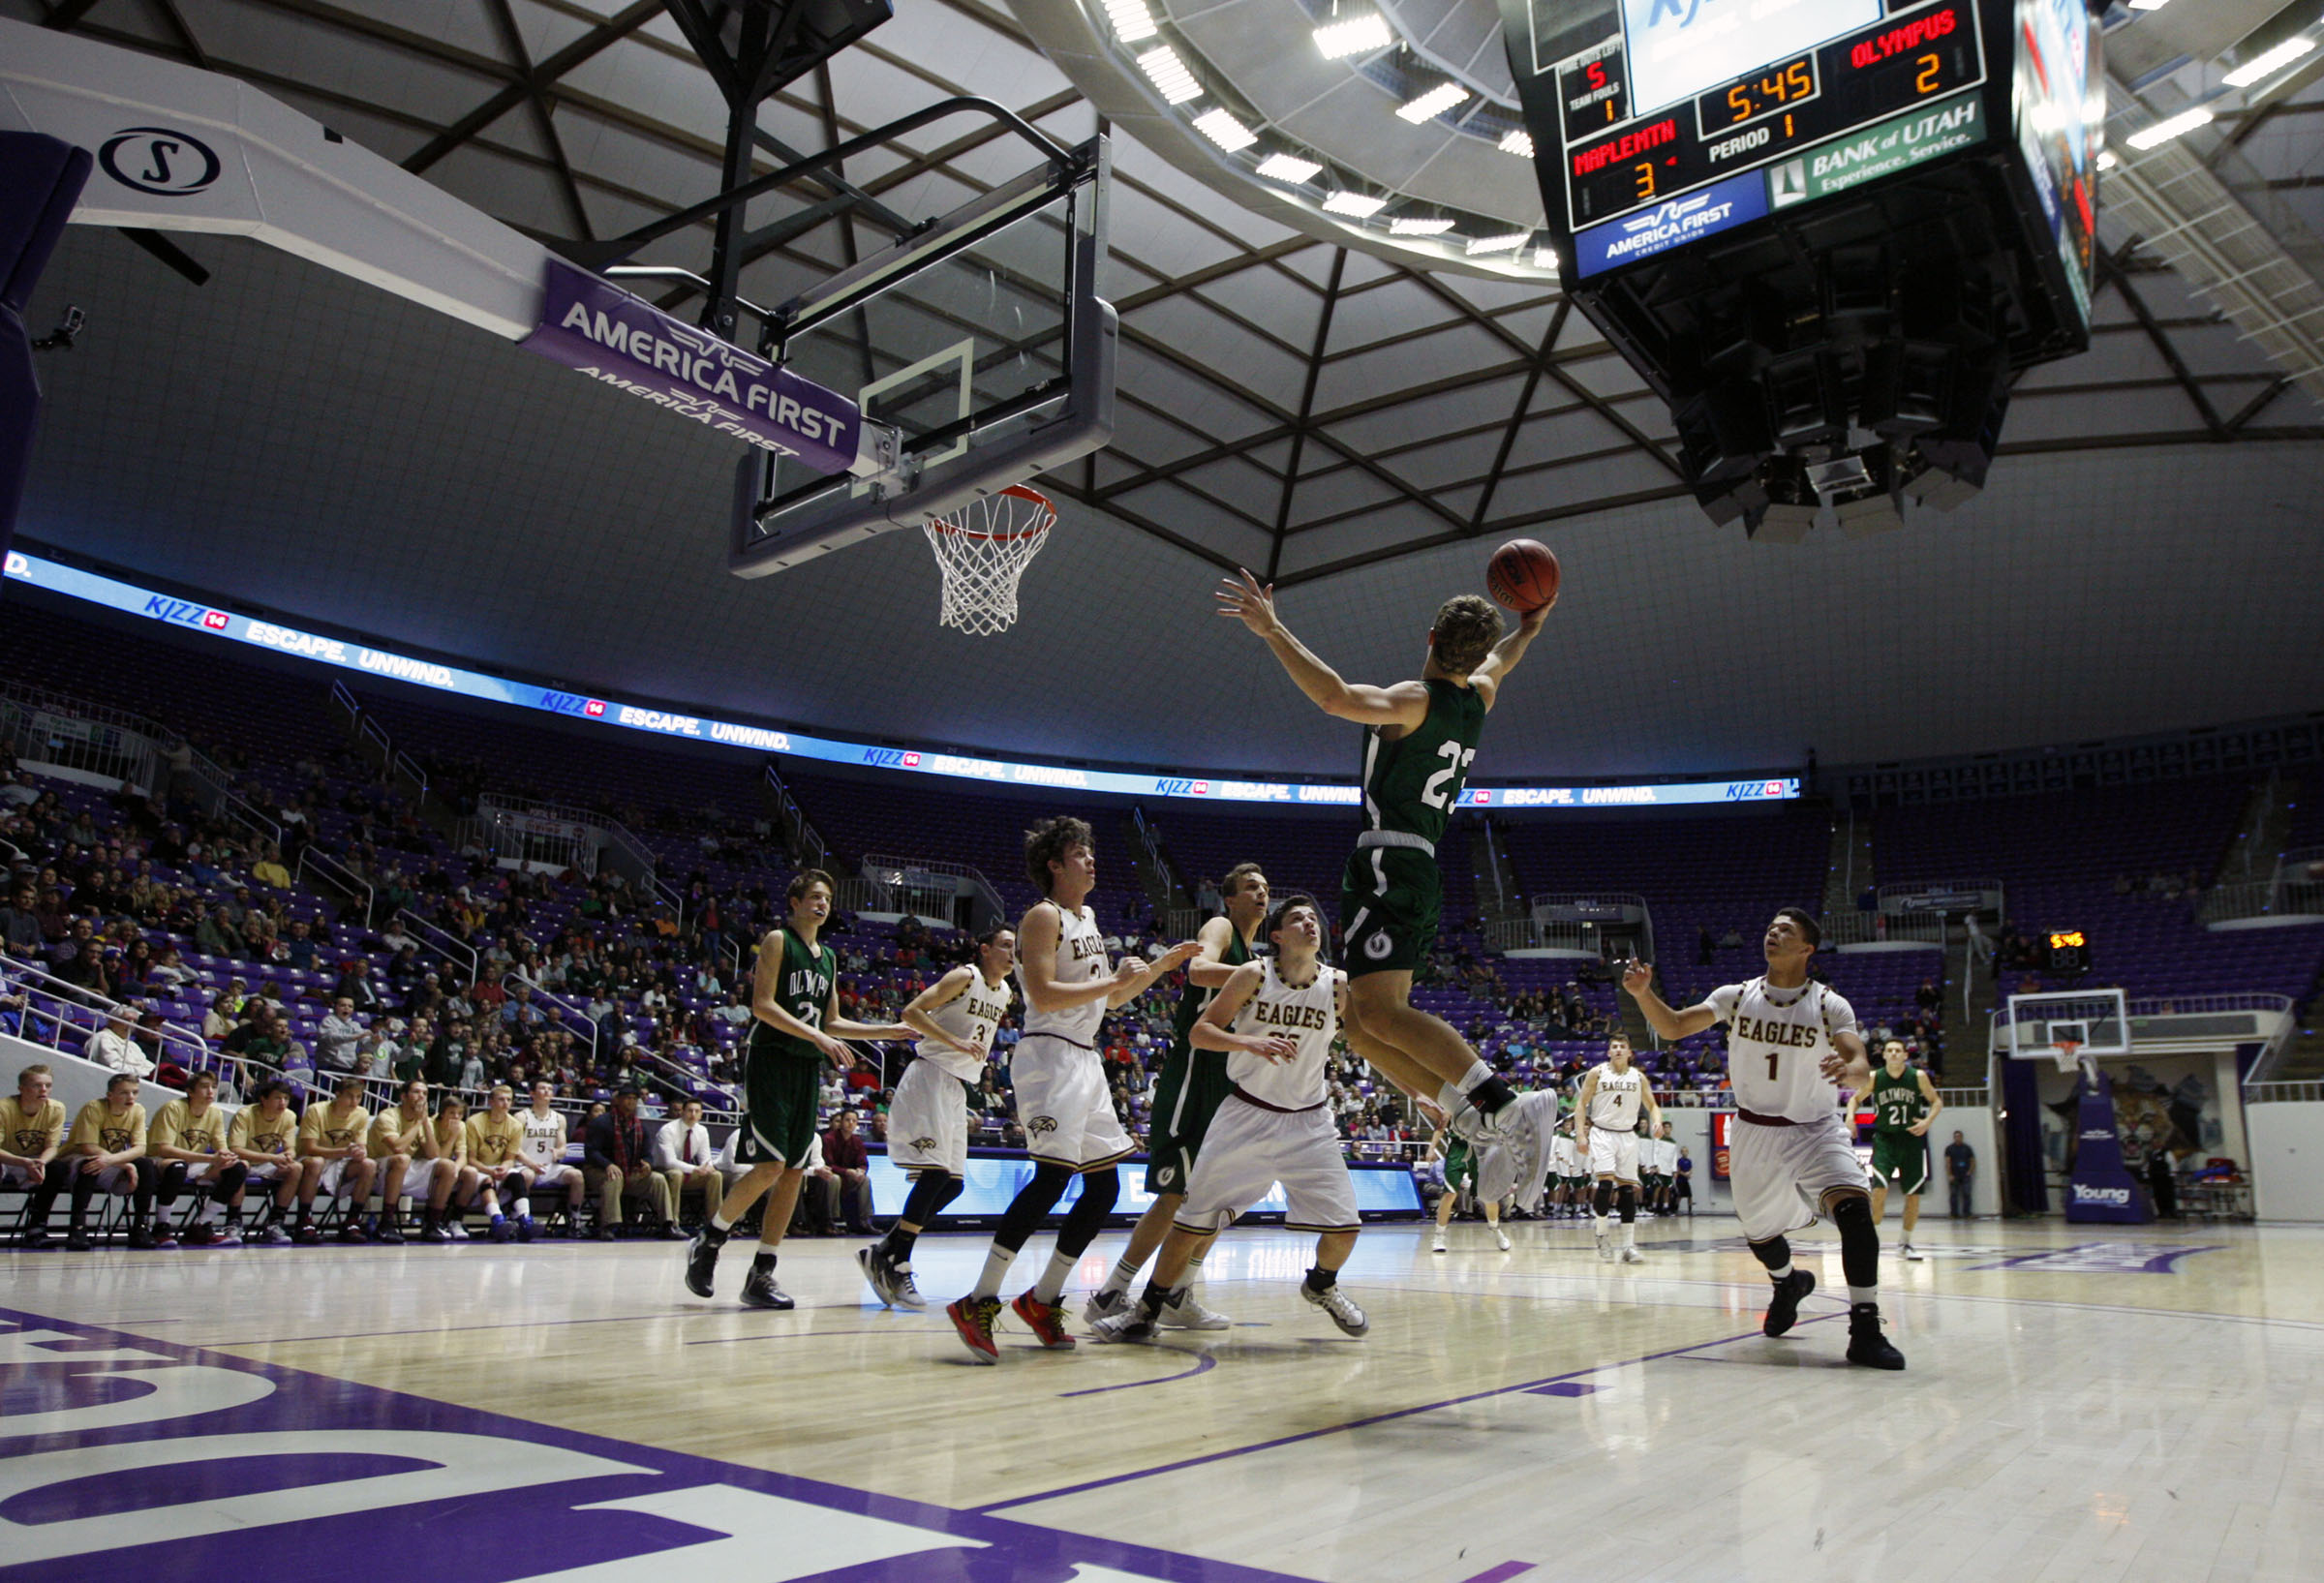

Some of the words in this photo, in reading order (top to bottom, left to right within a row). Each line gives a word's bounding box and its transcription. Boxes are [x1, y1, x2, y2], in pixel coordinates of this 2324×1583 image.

[1850, 9, 1956, 69] OLYMPUS
[1915, 53, 1940, 93] 2
[1569, 91, 1593, 111] TEAM
[1593, 81, 1620, 102] FOULS
[1728, 61, 1812, 122] 5:45
[1605, 100, 1614, 122] 1
[1785, 114, 1793, 137] 1
[1709, 127, 1770, 163] PERIOD
[1812, 136, 1880, 178] BANK
[1881, 131, 1900, 150] of
[1903, 101, 1976, 143] UTAH
[1820, 155, 1908, 194] Experience.
[1909, 132, 1972, 163] Service.
[1635, 162, 1655, 198] 3
[1606, 222, 1682, 259] AMERICA
[1682, 201, 1733, 232] FIRST
[1635, 240, 1669, 257] CREDIT
[1674, 228, 1705, 243] UNION
[561, 301, 741, 404] AMERICA
[747, 382, 847, 447] FIRST
[573, 366, 718, 427] AMERICA
[714, 420, 801, 458] FIRST
[144, 594, 206, 624] KJZZ
[246, 621, 347, 662] ESCAPE.
[358, 650, 455, 686] UNWIND.
[540, 691, 587, 715] KJZZ
[619, 707, 701, 736] ESCAPE.
[711, 721, 791, 751] UNWIND.
[863, 747, 904, 766] KJZZ
[933, 754, 1005, 778] ESCAPE.
[1014, 764, 1088, 787] UNWIND.
[1155, 778, 1194, 796] KJZZ
[1220, 781, 1291, 801] ESCAPE.
[1503, 789, 1574, 805] ESCAPE.
[1582, 787, 1657, 805] UNWIND.
[1726, 781, 1765, 802] KJZZ
[1255, 1000, 1327, 1031] EAGLES
[1737, 1017, 1819, 1049] EAGLES
[1764, 1052, 1780, 1081] 1
[1601, 1081, 1637, 1092] EAGLES
[1612, 1094, 1622, 1108] 4
[1879, 1087, 1915, 1106] OLYMPUS
[1888, 1105, 1908, 1125] 21
[527, 1127, 559, 1139] EAGLES
[536, 1141, 546, 1153] 5
[2072, 1183, 2130, 1205] Young
